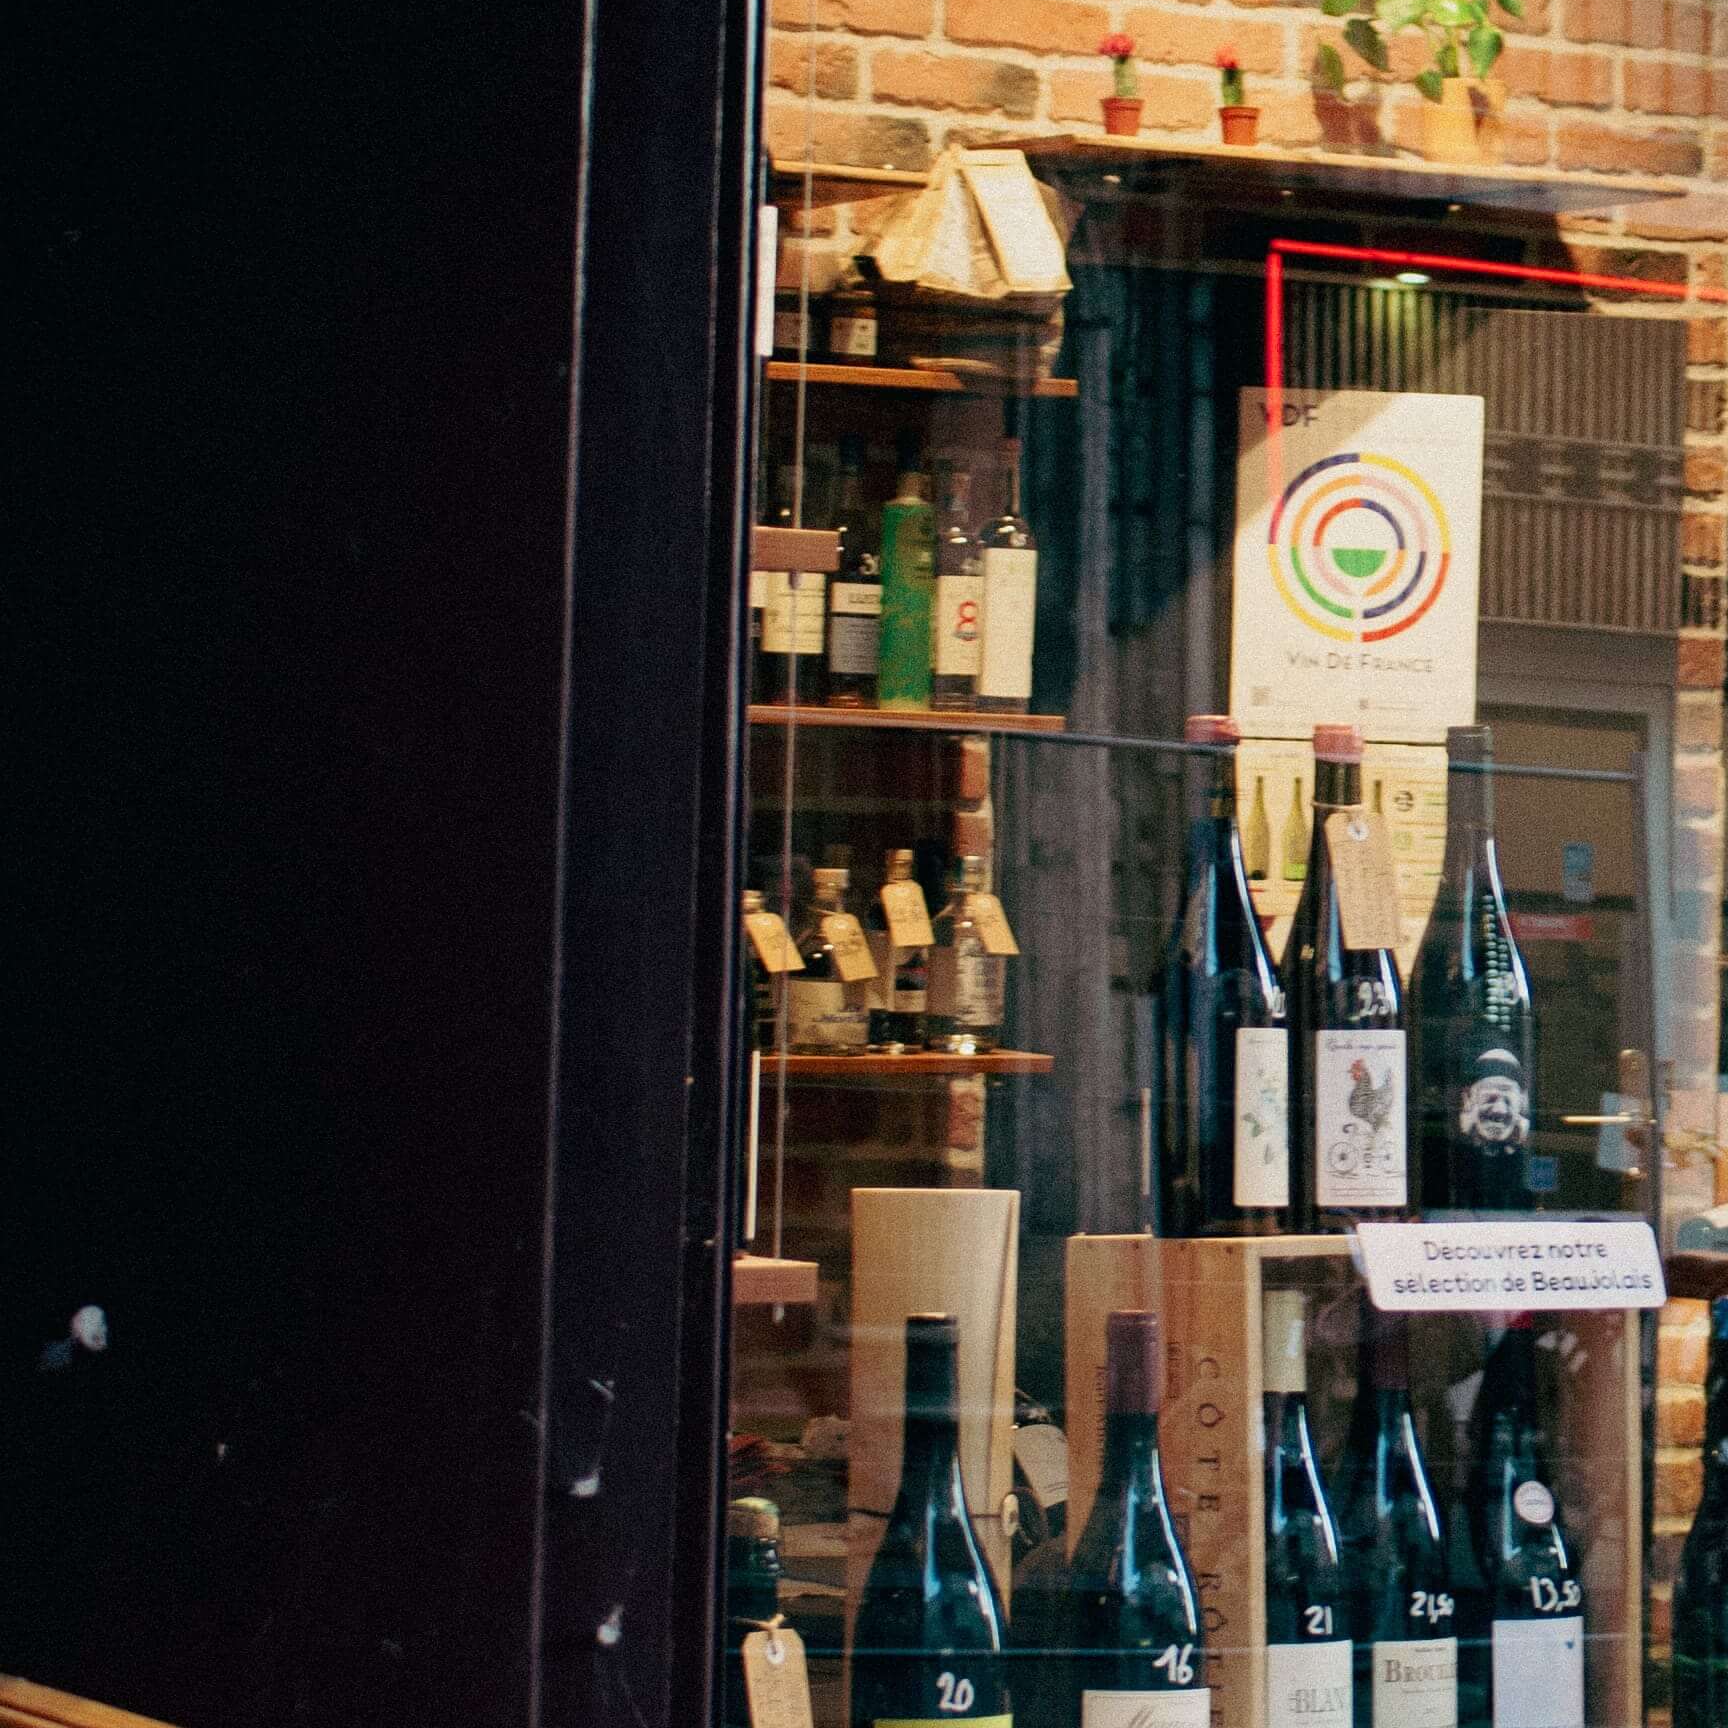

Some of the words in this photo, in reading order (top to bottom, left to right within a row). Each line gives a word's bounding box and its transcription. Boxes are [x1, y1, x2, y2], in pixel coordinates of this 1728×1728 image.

[1548, 1240, 1608, 1261] notre
[1502, 1270, 1527, 1293] de
[1304, 1604, 1334, 1636] 21
[1151, 1643, 1195, 1685] 16
[935, 1670, 976, 1713] 20
